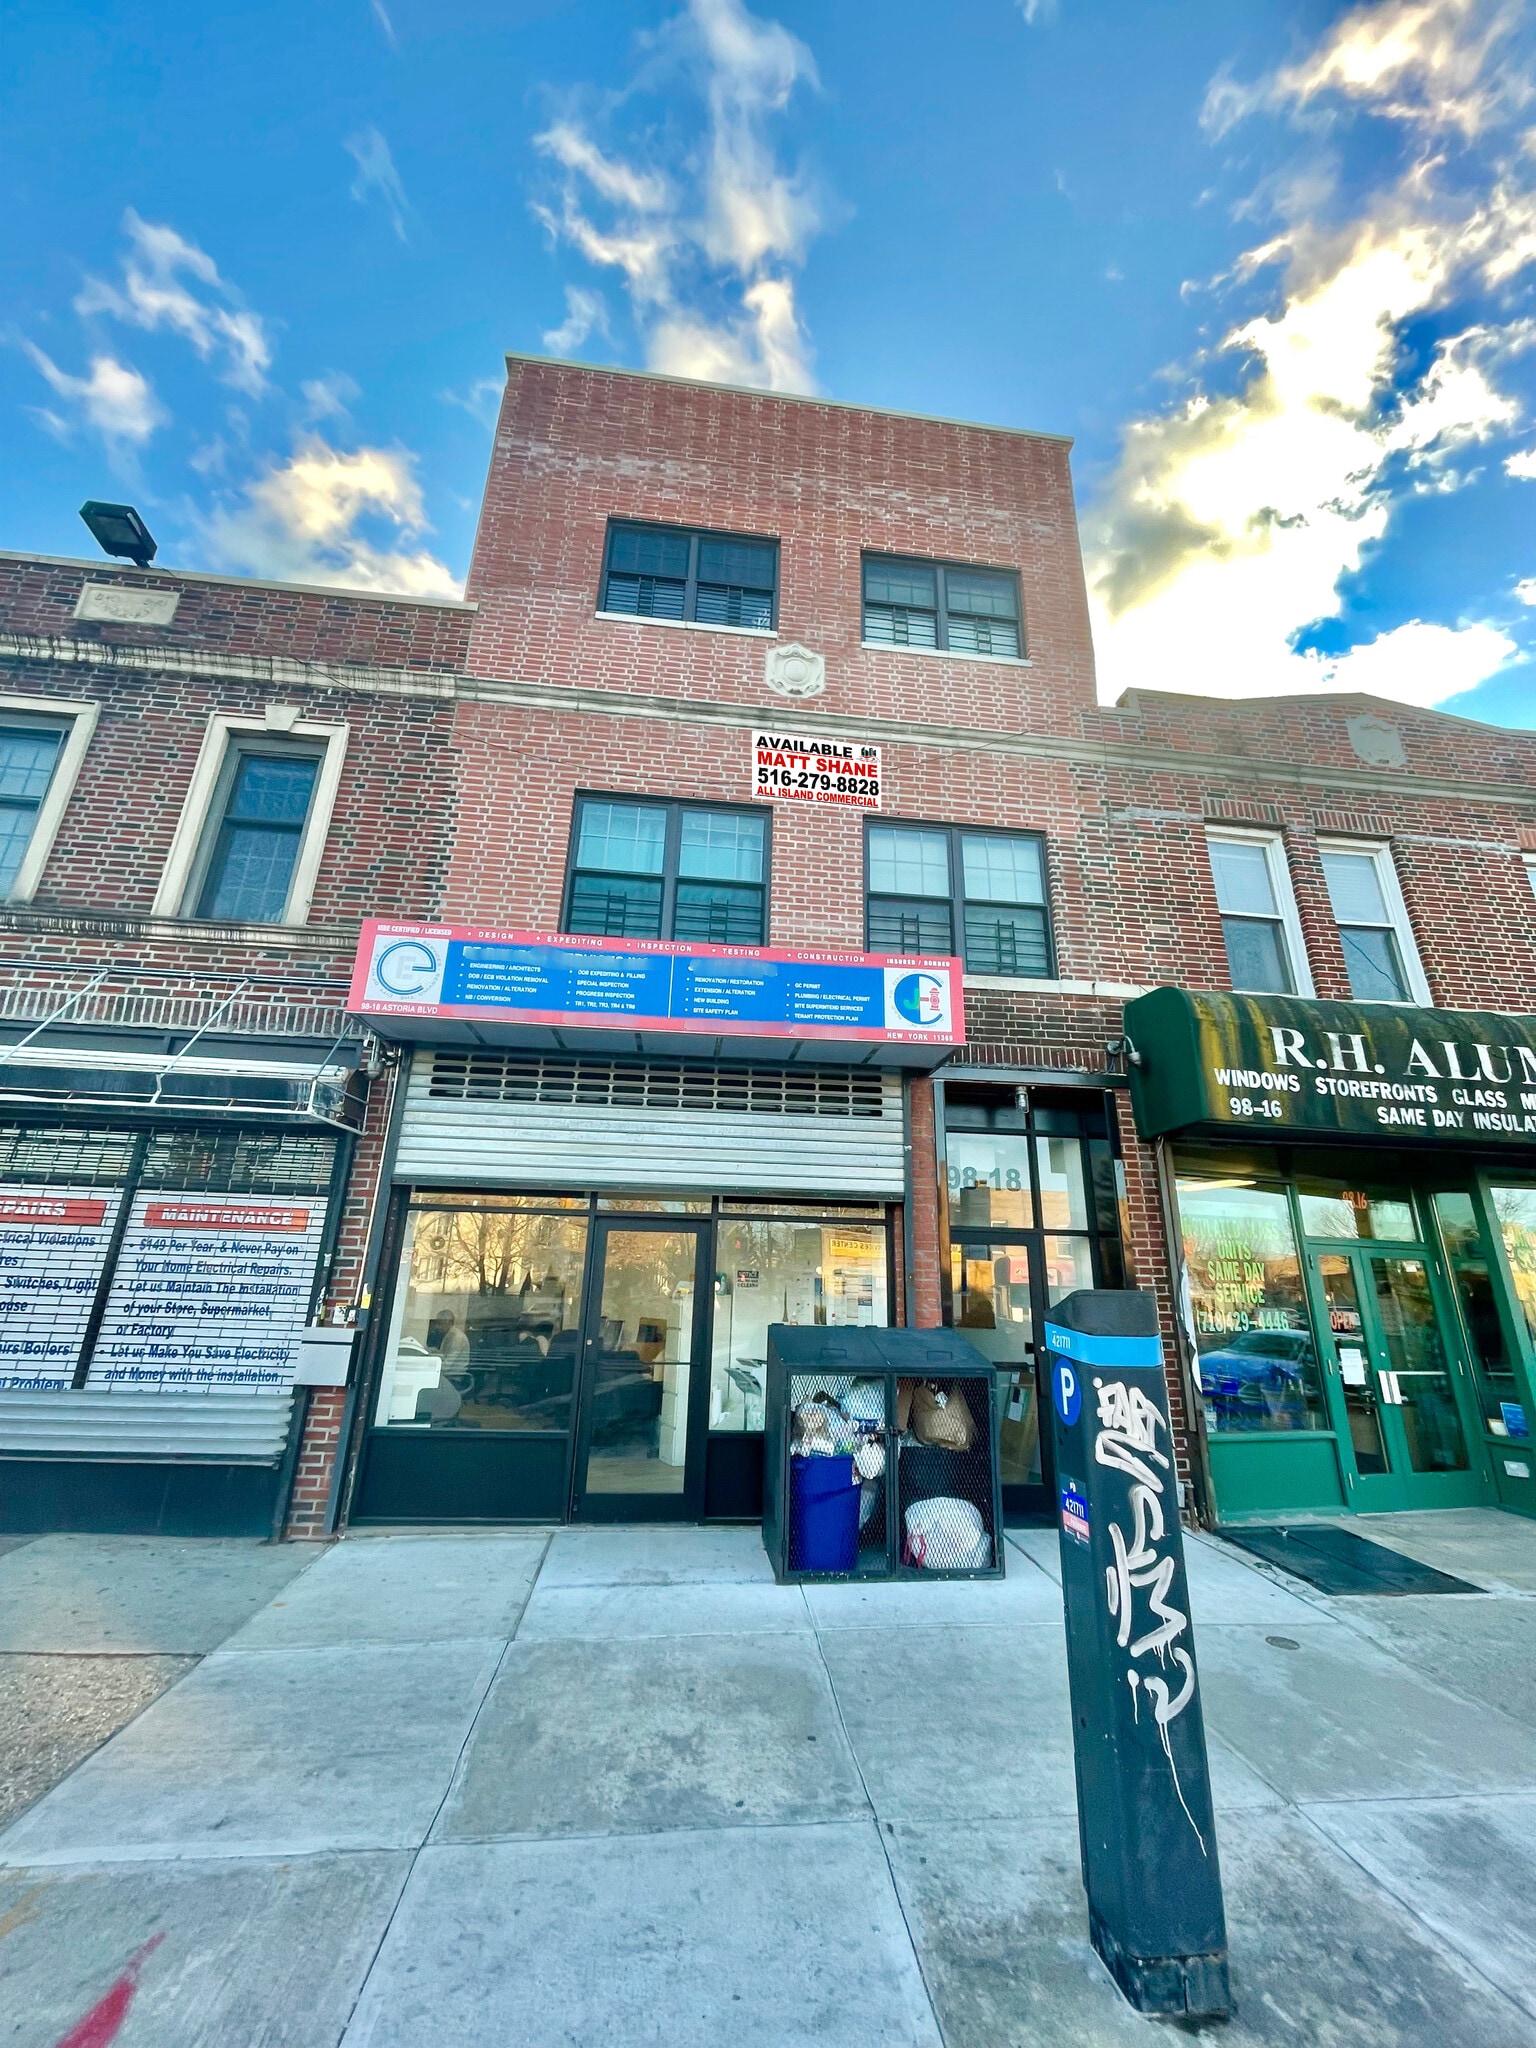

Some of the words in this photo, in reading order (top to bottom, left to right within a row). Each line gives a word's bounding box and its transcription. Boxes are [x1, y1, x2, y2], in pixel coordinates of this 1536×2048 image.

[756, 736, 852, 758] AVAILABLE
[758, 751, 810, 770] MATT
[816, 758, 878, 778] SHANE
[758, 768, 879, 796] 516-279-8828
[757, 786, 775, 796] ALL
[778, 788, 813, 800] ISLAND
[816, 792, 878, 806] COMMERCIAL
[392, 926, 420, 934] CERTIFIED
[478, 931, 514, 939] DESIGN
[547, 936, 602, 946] EXPEDITING
[637, 942, 692, 952] INSPECTION
[722, 948, 760, 956] TESTING
[798, 952, 865, 962] CONSTRUCTION
[382, 1004, 415, 1013] ASTORIA
[418, 1006, 438, 1014] BLVD
[1267, 1026, 1385, 1074] R.H.
[1214, 1068, 1300, 1092] WINDOWS
[1315, 1076, 1438, 1103] STOREFRONTS
[1452, 1089, 1507, 1109] GLASS
[1229, 1097, 1282, 1118] 98-16
[1377, 1106, 1427, 1126] SAME
[1432, 1110, 1465, 1128] DAY
[0, 1200, 67, 1216] PAIRS
[161, 1208, 294, 1226] MAINTENANCE
[40, 1232, 96, 1246] Violations
[169, 1239, 187, 1251] Per
[191, 1240, 214, 1253] Year
[220, 1242, 227, 1253] &
[231, 1242, 261, 1255] Never
[264, 1243, 284, 1257] Pay
[286, 1246, 299, 1255] on
[1217, 1240, 1251, 1260] UNITS
[136, 1259, 159, 1272] Your
[163, 1260, 193, 1274] Home
[196, 1260, 247, 1275] Electrical
[250, 1260, 292, 1278] Repairs.
[1207, 1261, 1240, 1281] SAME
[1244, 1262, 1265, 1281] DAY
[5, 1276, 62, 1292] Switches,
[66, 1277, 97, 1293] Light
[129, 1280, 147, 1292] Let
[150, 1283, 162, 1292] us
[166, 1281, 212, 1294] Maintain
[216, 1281, 236, 1294] The
[239, 1282, 298, 1296] Installation
[1215, 1283, 1265, 1304] SERVICE
[124, 1301, 135, 1313] of
[136, 1304, 162, 1316] your
[164, 1302, 196, 1317] Store,
[116, 1326, 128, 1335] or
[131, 1324, 174, 1339] Factory
[23, 1341, 71, 1355] Boilers
[1052, 1334, 1070, 1349] 421711
[110, 1344, 130, 1358] Let
[133, 1348, 145, 1358] us
[148, 1345, 178, 1358] Make
[182, 1345, 202, 1359] You
[205, 1346, 230, 1359] Save
[234, 1347, 290, 1361] Electricity
[104, 1368, 126, 1380] and
[130, 1367, 165, 1382] Money
[169, 1368, 194, 1380] with
[196, 1369, 213, 1381] the
[217, 1369, 278, 1382] installation
[1060, 1367, 1075, 1416] P
